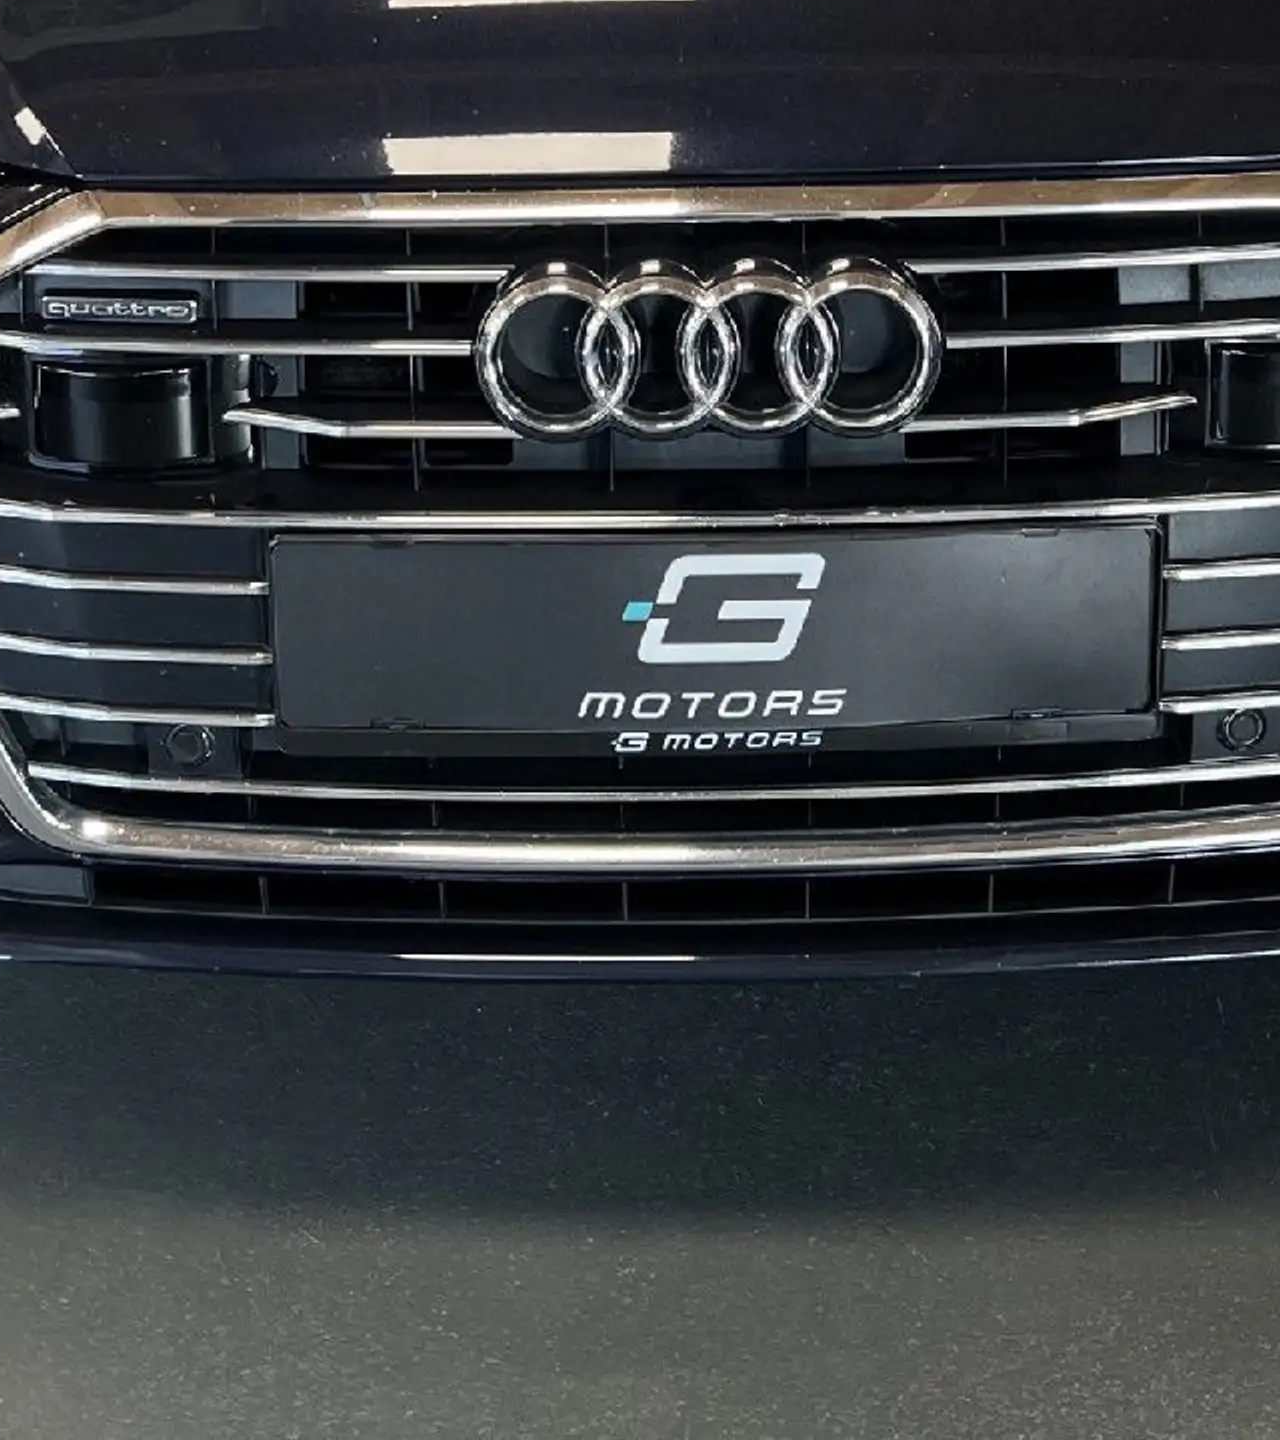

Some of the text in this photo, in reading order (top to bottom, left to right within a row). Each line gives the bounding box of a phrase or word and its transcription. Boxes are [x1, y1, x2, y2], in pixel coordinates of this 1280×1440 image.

[47, 301, 190, 318] quattro
[624, 553, 826, 664] G
[577, 688, 848, 720] MOTORS
[662, 730, 825, 752] MOTORS
